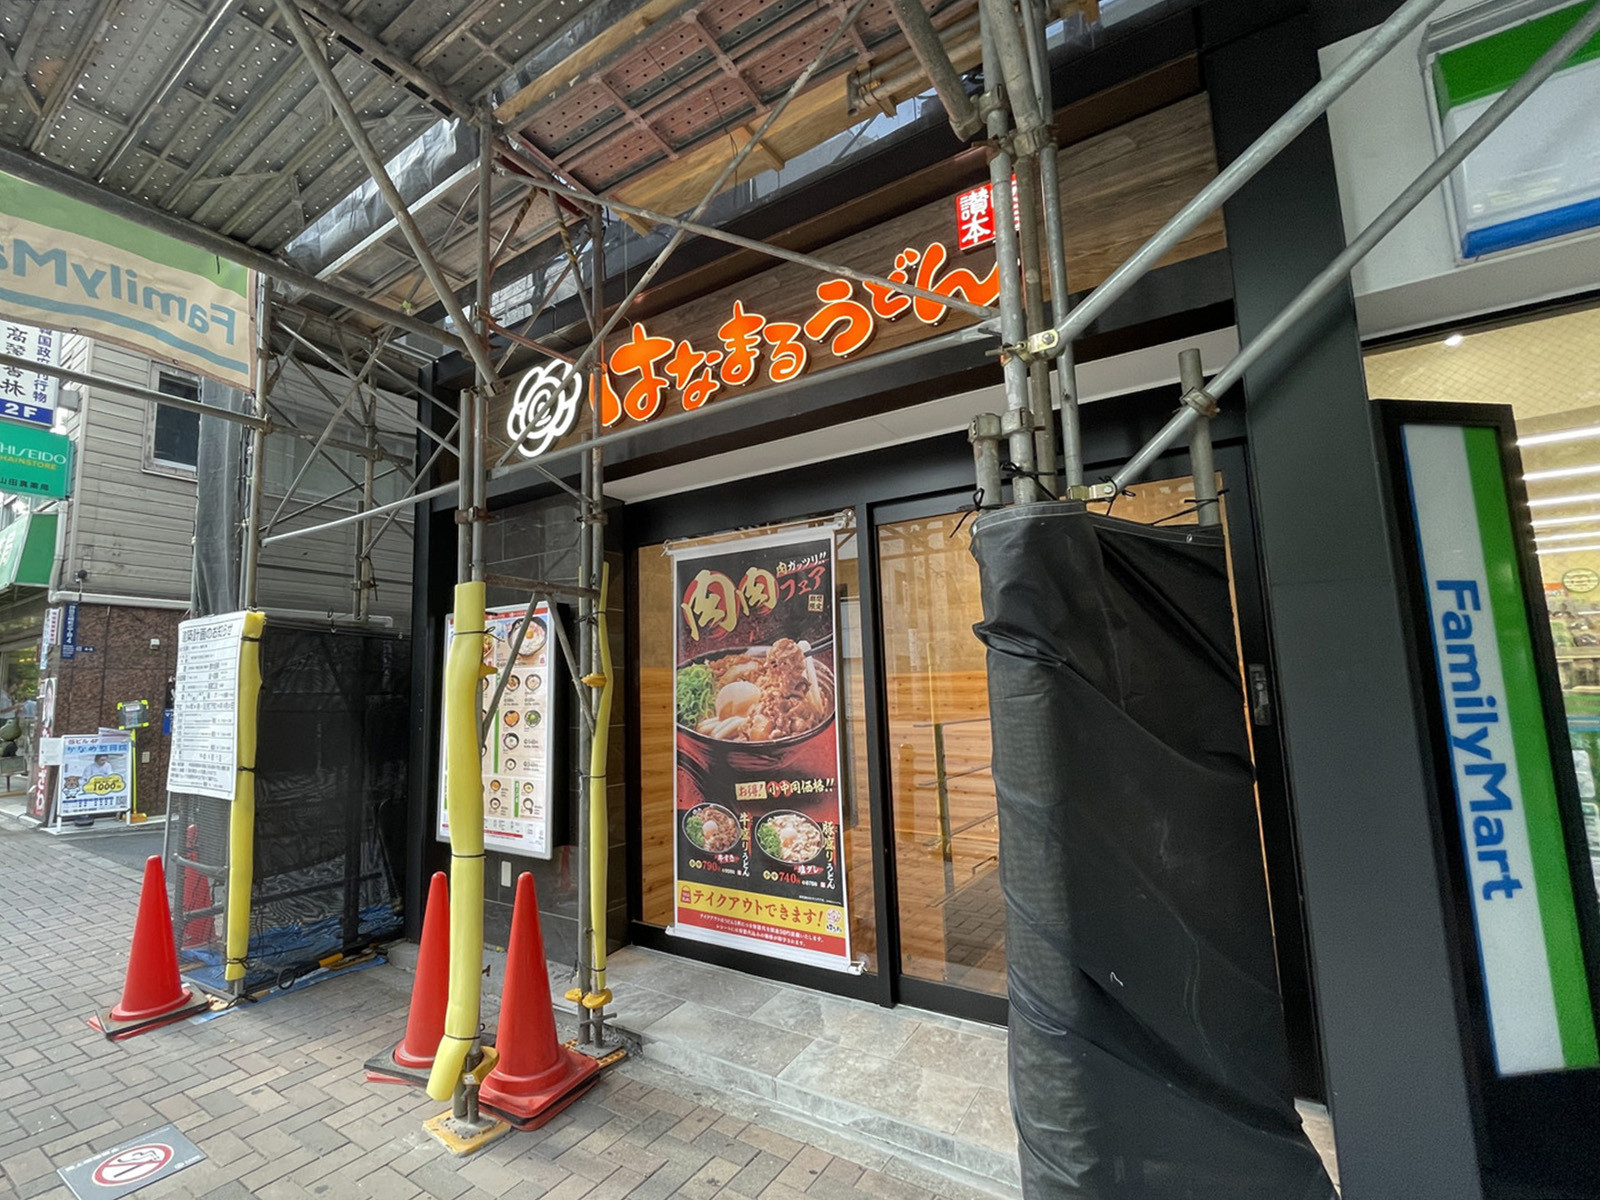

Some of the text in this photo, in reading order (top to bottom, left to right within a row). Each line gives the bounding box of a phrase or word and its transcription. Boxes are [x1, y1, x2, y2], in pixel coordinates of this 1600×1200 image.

[589, 242, 1001, 427] はなまるうどん
[4, 403, 38, 418] 2F
[0, 441, 66, 465] HISEIDO
[0, 455, 57, 470] HAINSTORE
[779, 566, 826, 602] フェア
[1436, 580, 1523, 901] FamilyMart
[693, 890, 823, 927] テイクアウトできます!
